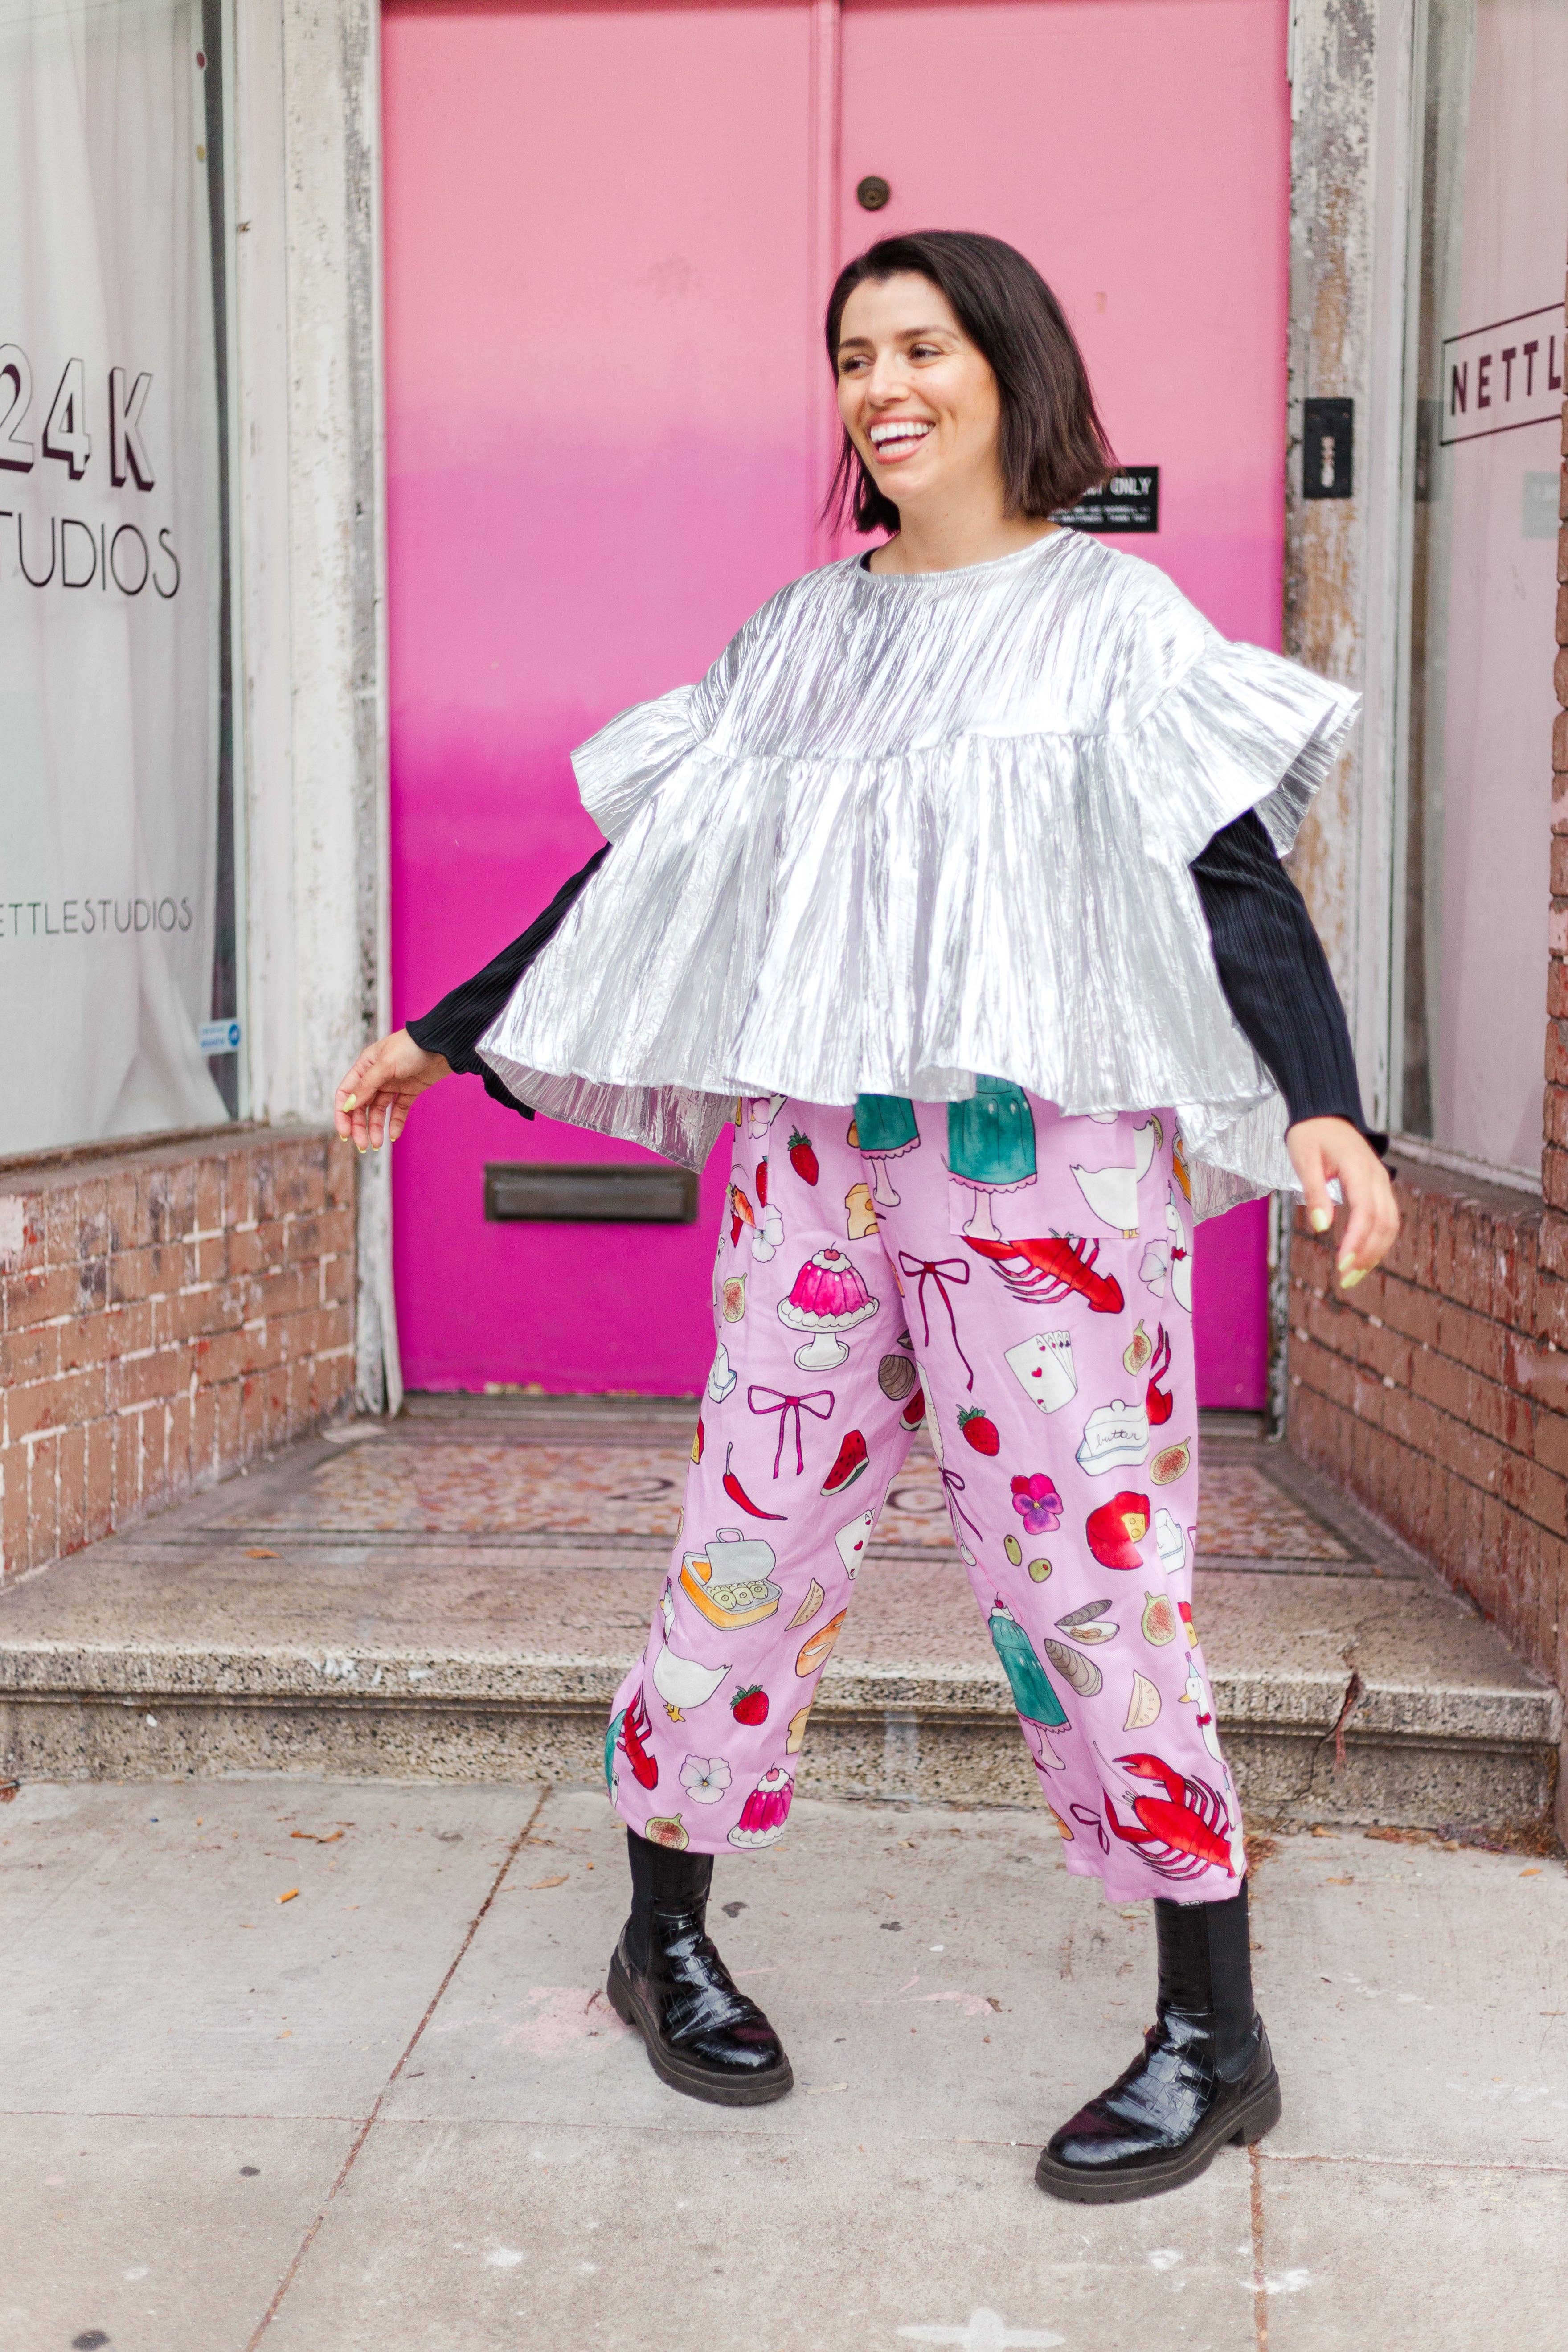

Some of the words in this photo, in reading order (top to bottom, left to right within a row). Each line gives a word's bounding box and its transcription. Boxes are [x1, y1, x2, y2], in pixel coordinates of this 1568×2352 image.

[1110, 476, 1152, 496] ONLY
[0, 897, 193, 935] TTLESTUDIOS
[1096, 1429, 1142, 1449] butter
